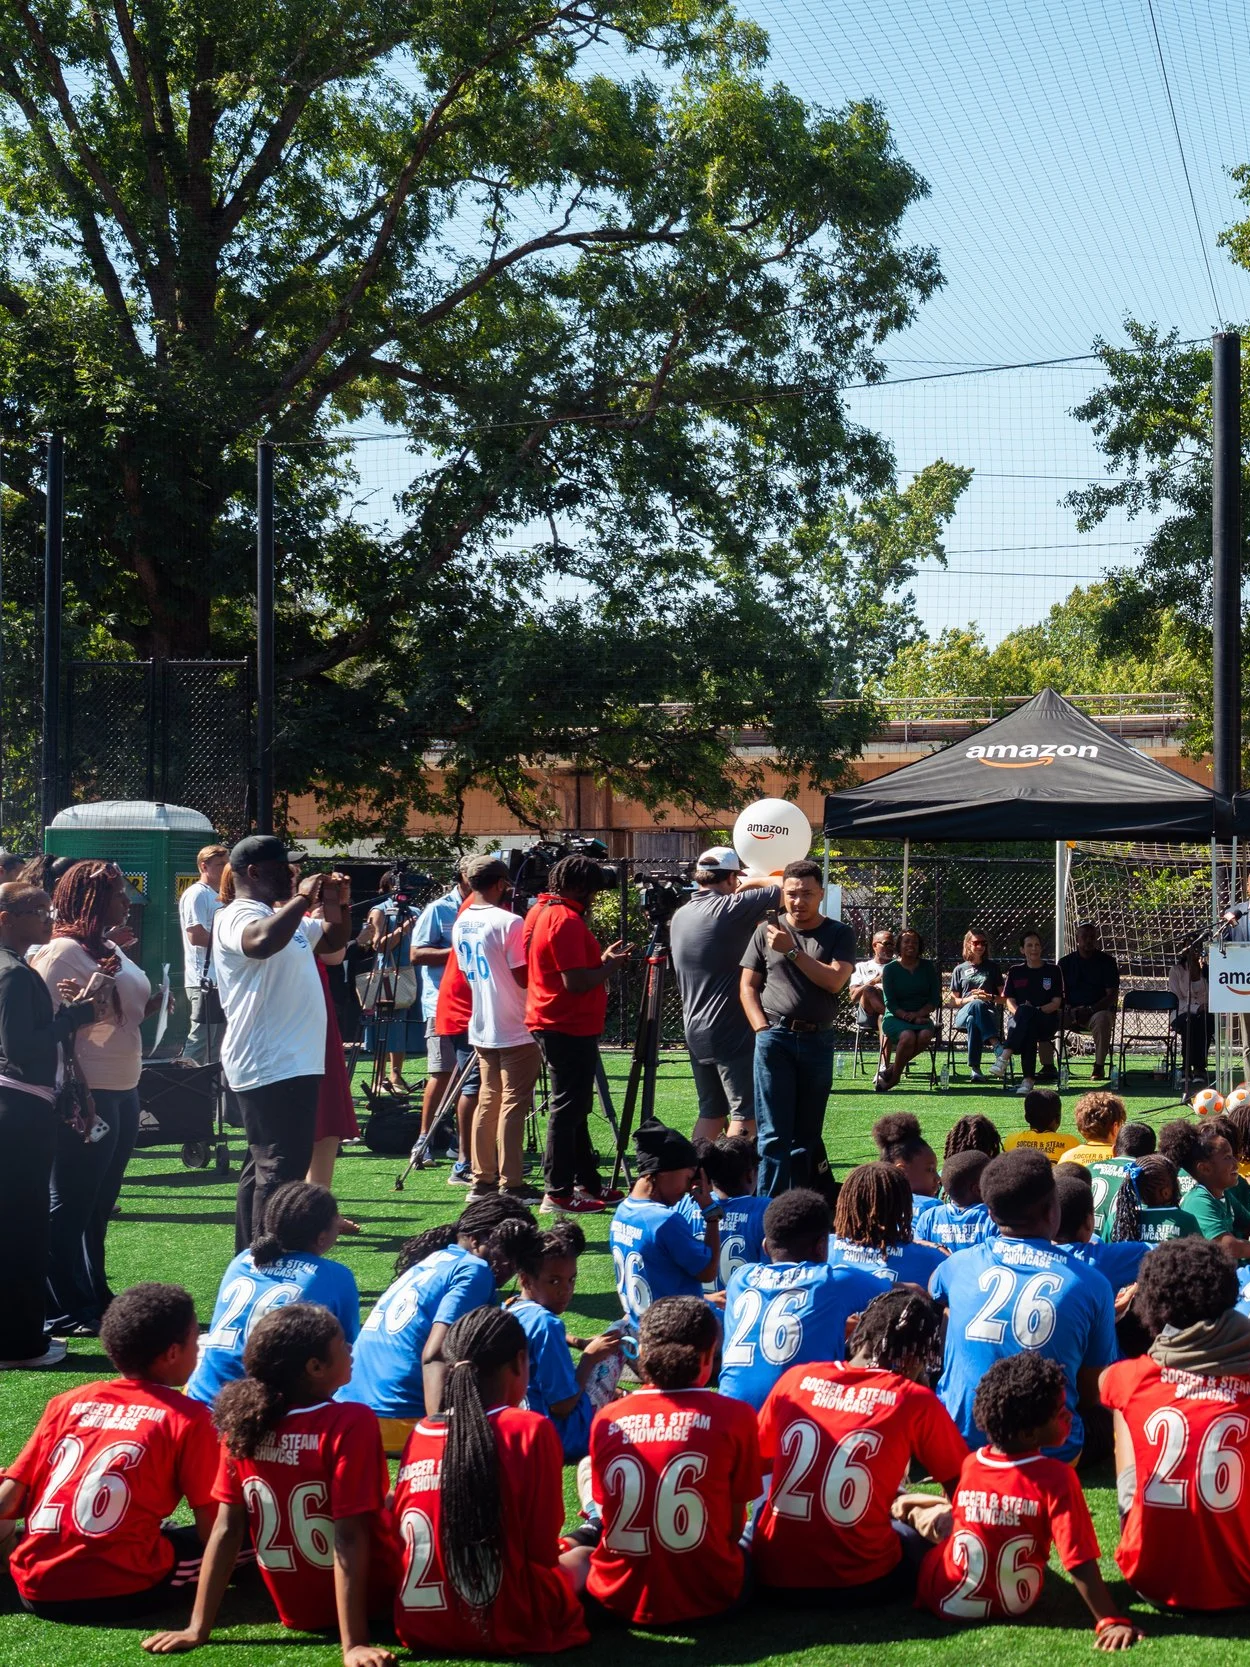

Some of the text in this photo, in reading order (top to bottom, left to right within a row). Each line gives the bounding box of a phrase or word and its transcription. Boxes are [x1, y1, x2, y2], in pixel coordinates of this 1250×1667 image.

[966, 744, 1098, 759] amazon
[747, 823, 789, 836] amazon
[458, 939, 490, 983] 26
[703, 1220, 737, 1231] SCASE
[726, 1212, 748, 1222] STEAM
[1140, 1232, 1168, 1241] OWCASE
[1148, 1224, 1180, 1236] & STEAM
[286, 1259, 318, 1274] STEAM
[1001, 1252, 1051, 1268] SHOWCASE
[965, 1265, 1064, 1350] 26
[723, 1288, 809, 1367] 26
[1161, 1368, 1205, 1386] SOCCER
[1206, 1374, 1217, 1388] &
[800, 1376, 896, 1406] SOCCER & STEAM
[1175, 1384, 1237, 1404] SHOWCASE
[70, 1402, 166, 1423] SOCCER & STEAM
[812, 1394, 874, 1416] SHOWCASE
[79, 1413, 138, 1431] SHOWCASE
[609, 1413, 711, 1434] SOCCER & STEAM
[281, 1433, 319, 1451] STEAM
[622, 1427, 689, 1444] SHOWCASE
[254, 1448, 299, 1466] SHOWCSE
[1143, 1406, 1250, 1513] 26
[399, 1459, 435, 1482] SOCCER
[773, 1419, 883, 1527] 26
[29, 1435, 145, 1537] 26
[410, 1474, 441, 1493] SHOW
[603, 1452, 708, 1557] 26
[989, 1494, 999, 1508] &
[1001, 1496, 1038, 1517] STEAM
[242, 1476, 335, 1572] 26
[965, 1506, 1020, 1526] SHOWCASE
[940, 1529, 1043, 1620] 26
